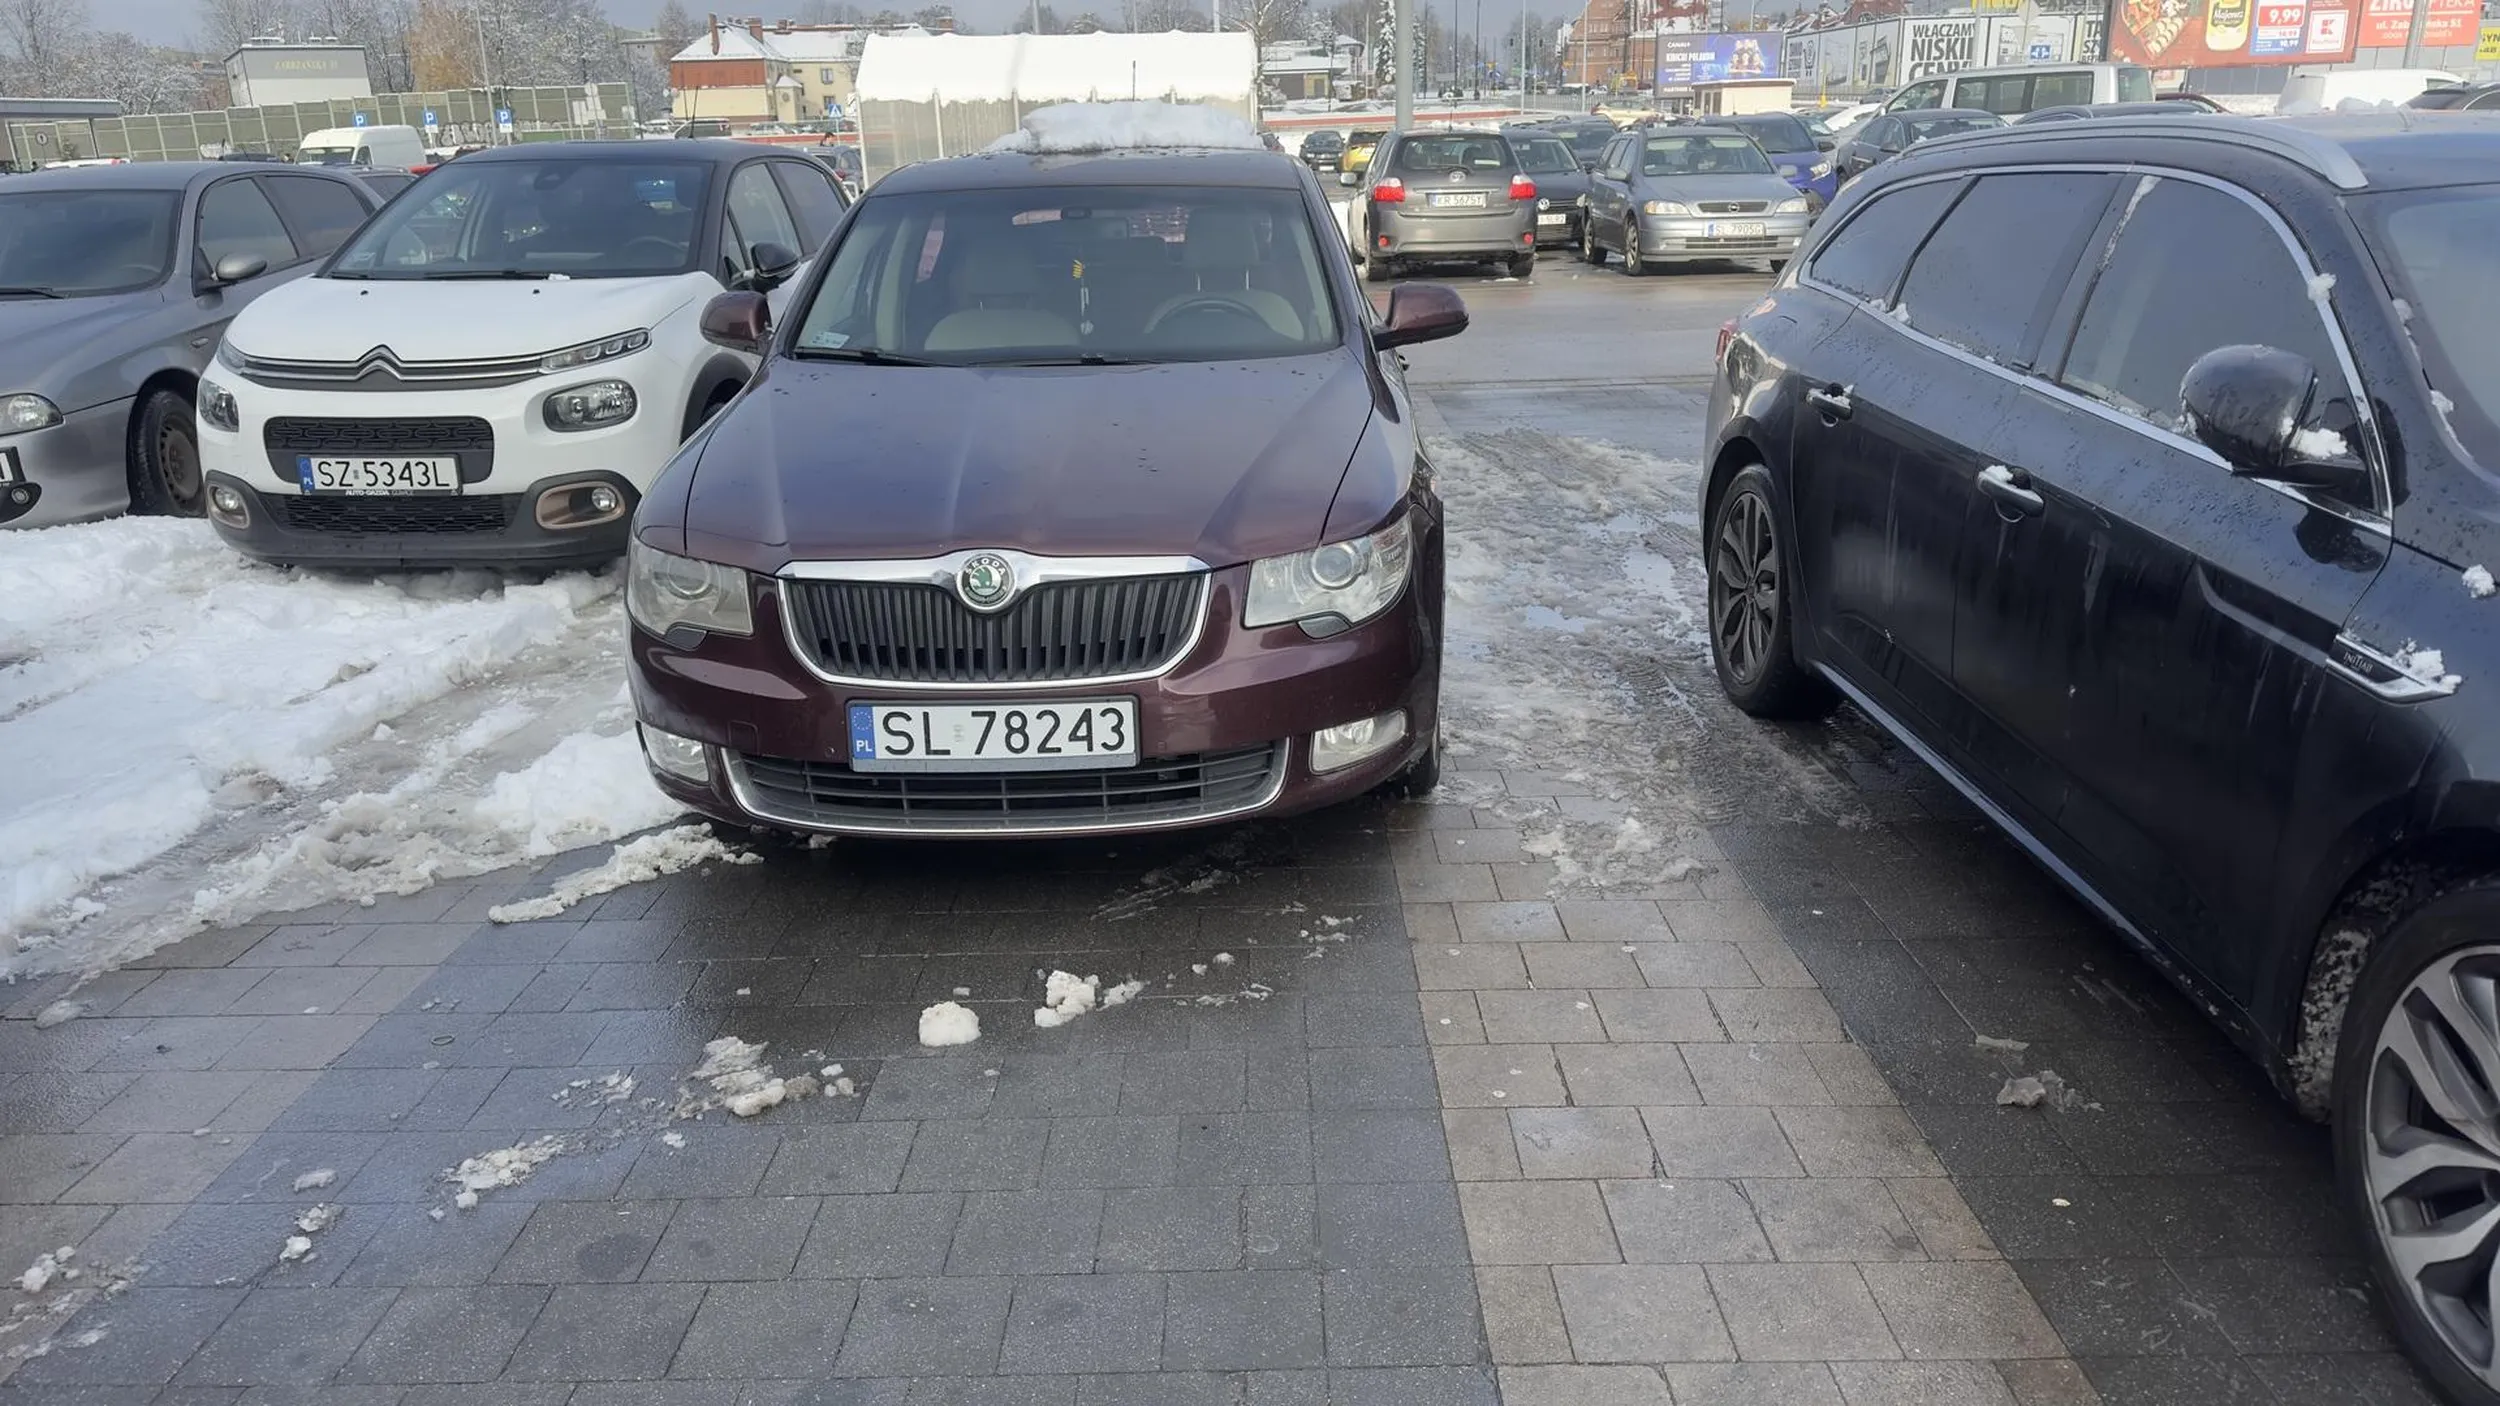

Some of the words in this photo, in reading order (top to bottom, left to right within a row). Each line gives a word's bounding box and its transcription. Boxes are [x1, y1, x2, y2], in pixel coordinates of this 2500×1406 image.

[2269, 8, 2301, 24] 9,99
[317, 460, 354, 487] SZ
[362, 460, 450, 488] 5343L
[856, 738, 872, 752] PL
[882, 710, 951, 756] SL
[970, 707, 1126, 756] 78243
